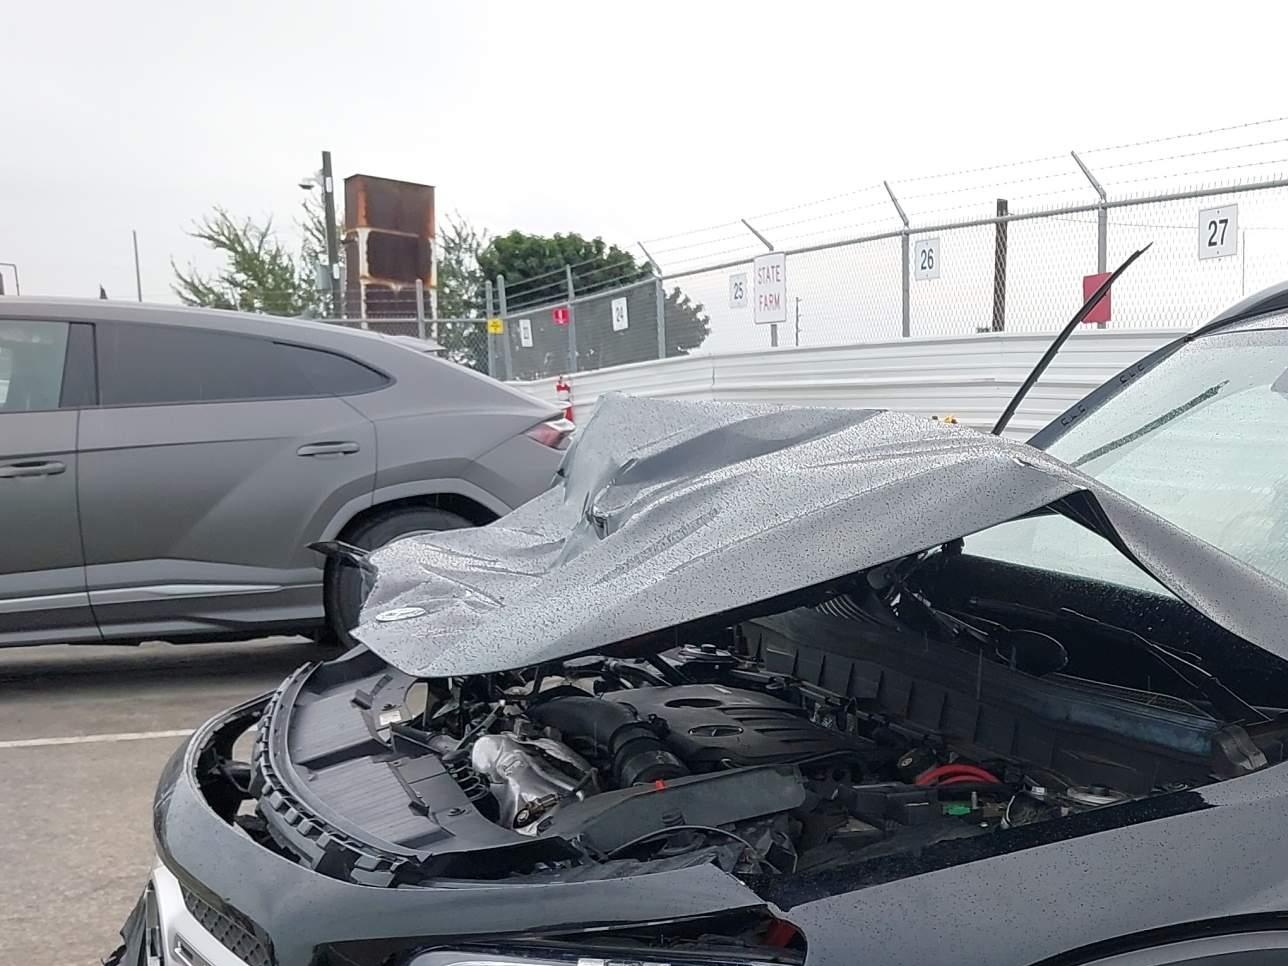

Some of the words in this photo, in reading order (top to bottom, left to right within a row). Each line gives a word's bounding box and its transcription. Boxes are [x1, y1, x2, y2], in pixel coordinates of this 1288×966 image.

[1207, 218, 1229, 248] 27
[920, 248, 934, 271] 26
[757, 265, 782, 285] STATE
[733, 281, 744, 300] 25
[759, 292, 782, 313] FARM
